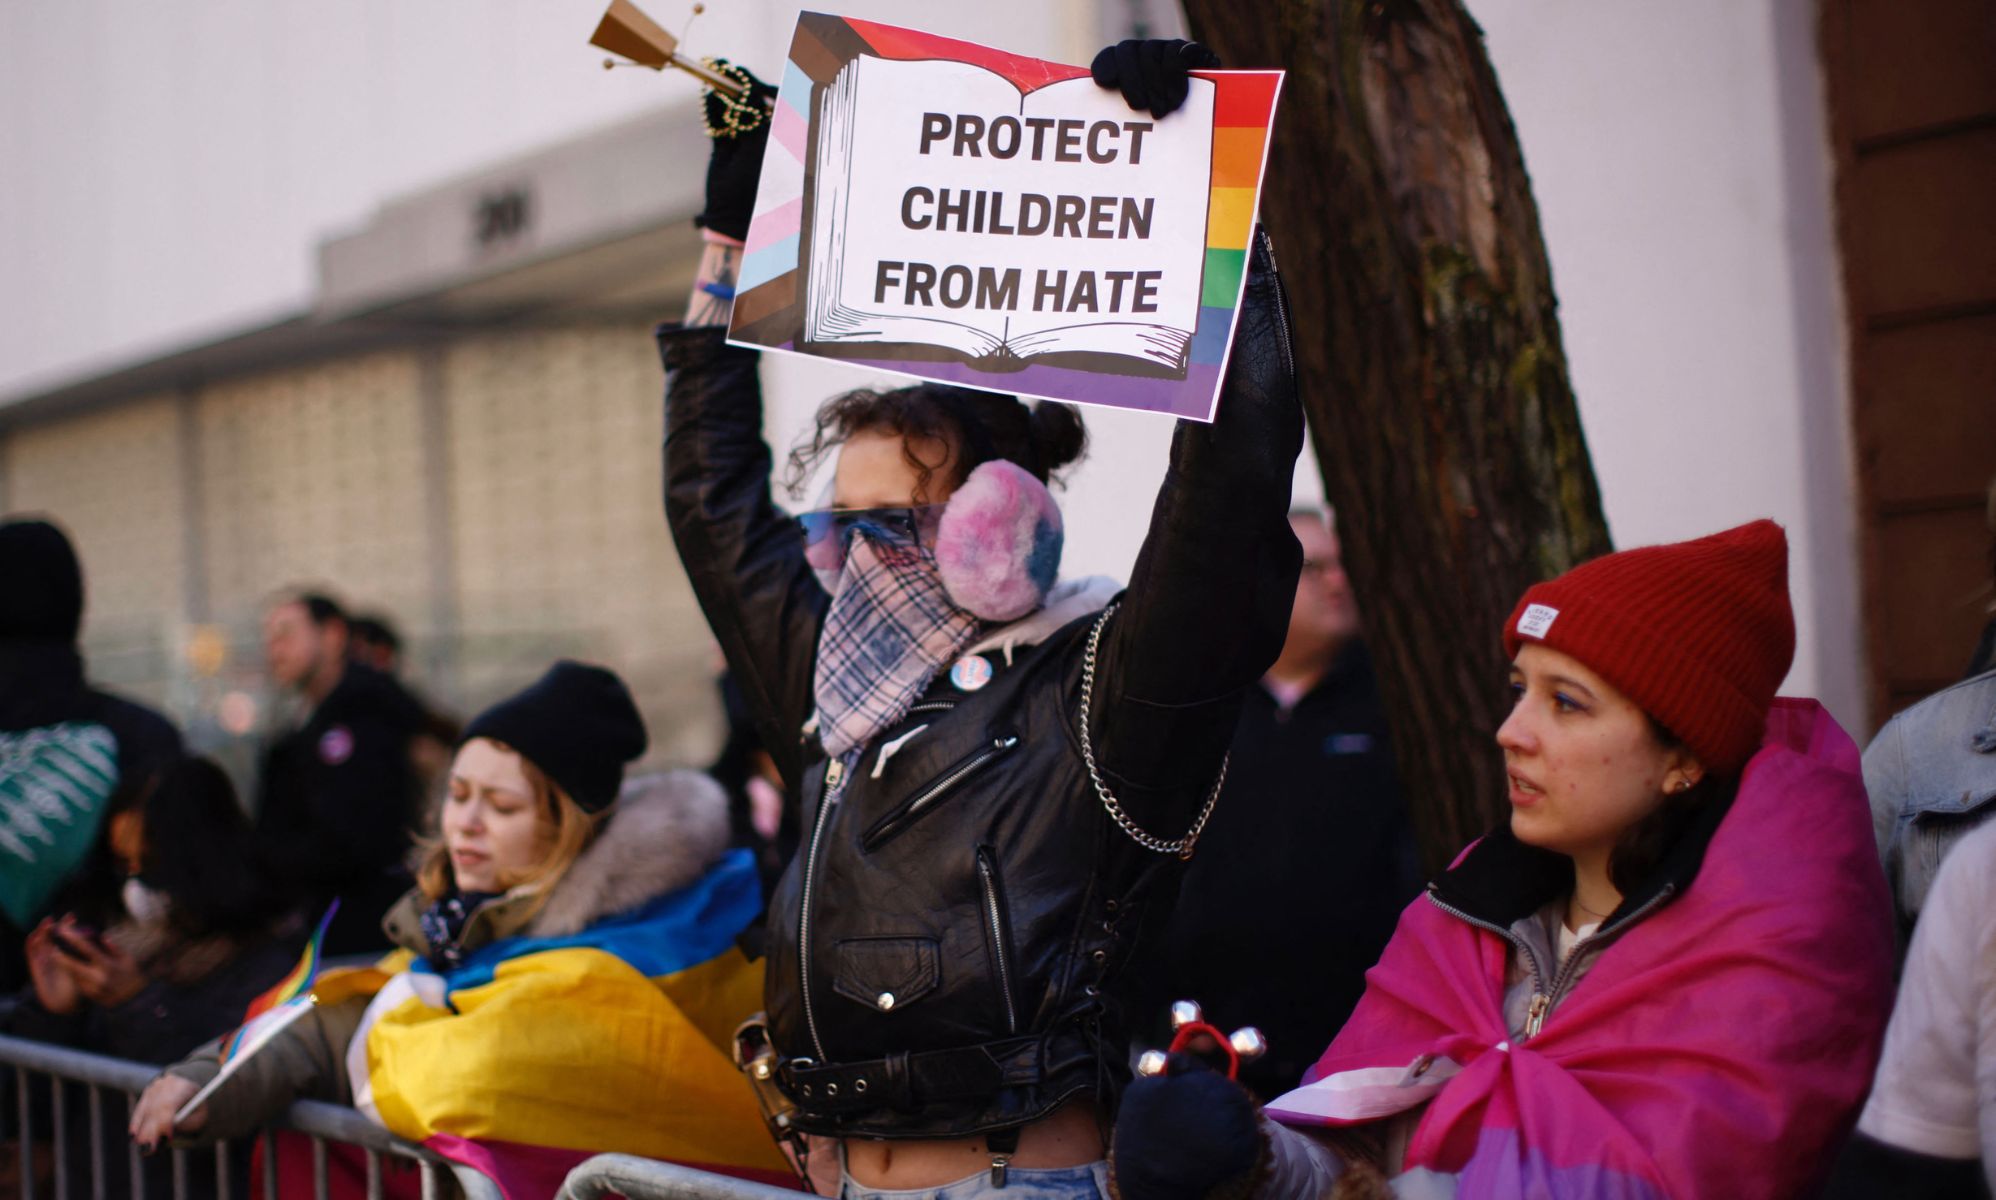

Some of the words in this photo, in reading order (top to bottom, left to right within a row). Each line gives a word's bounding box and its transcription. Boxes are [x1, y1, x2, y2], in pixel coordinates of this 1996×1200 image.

[919, 112, 1154, 165] PROTECT
[901, 186, 1155, 239] CHILDREN
[874, 260, 1021, 312] FROM
[1033, 269, 1163, 313] HATE
